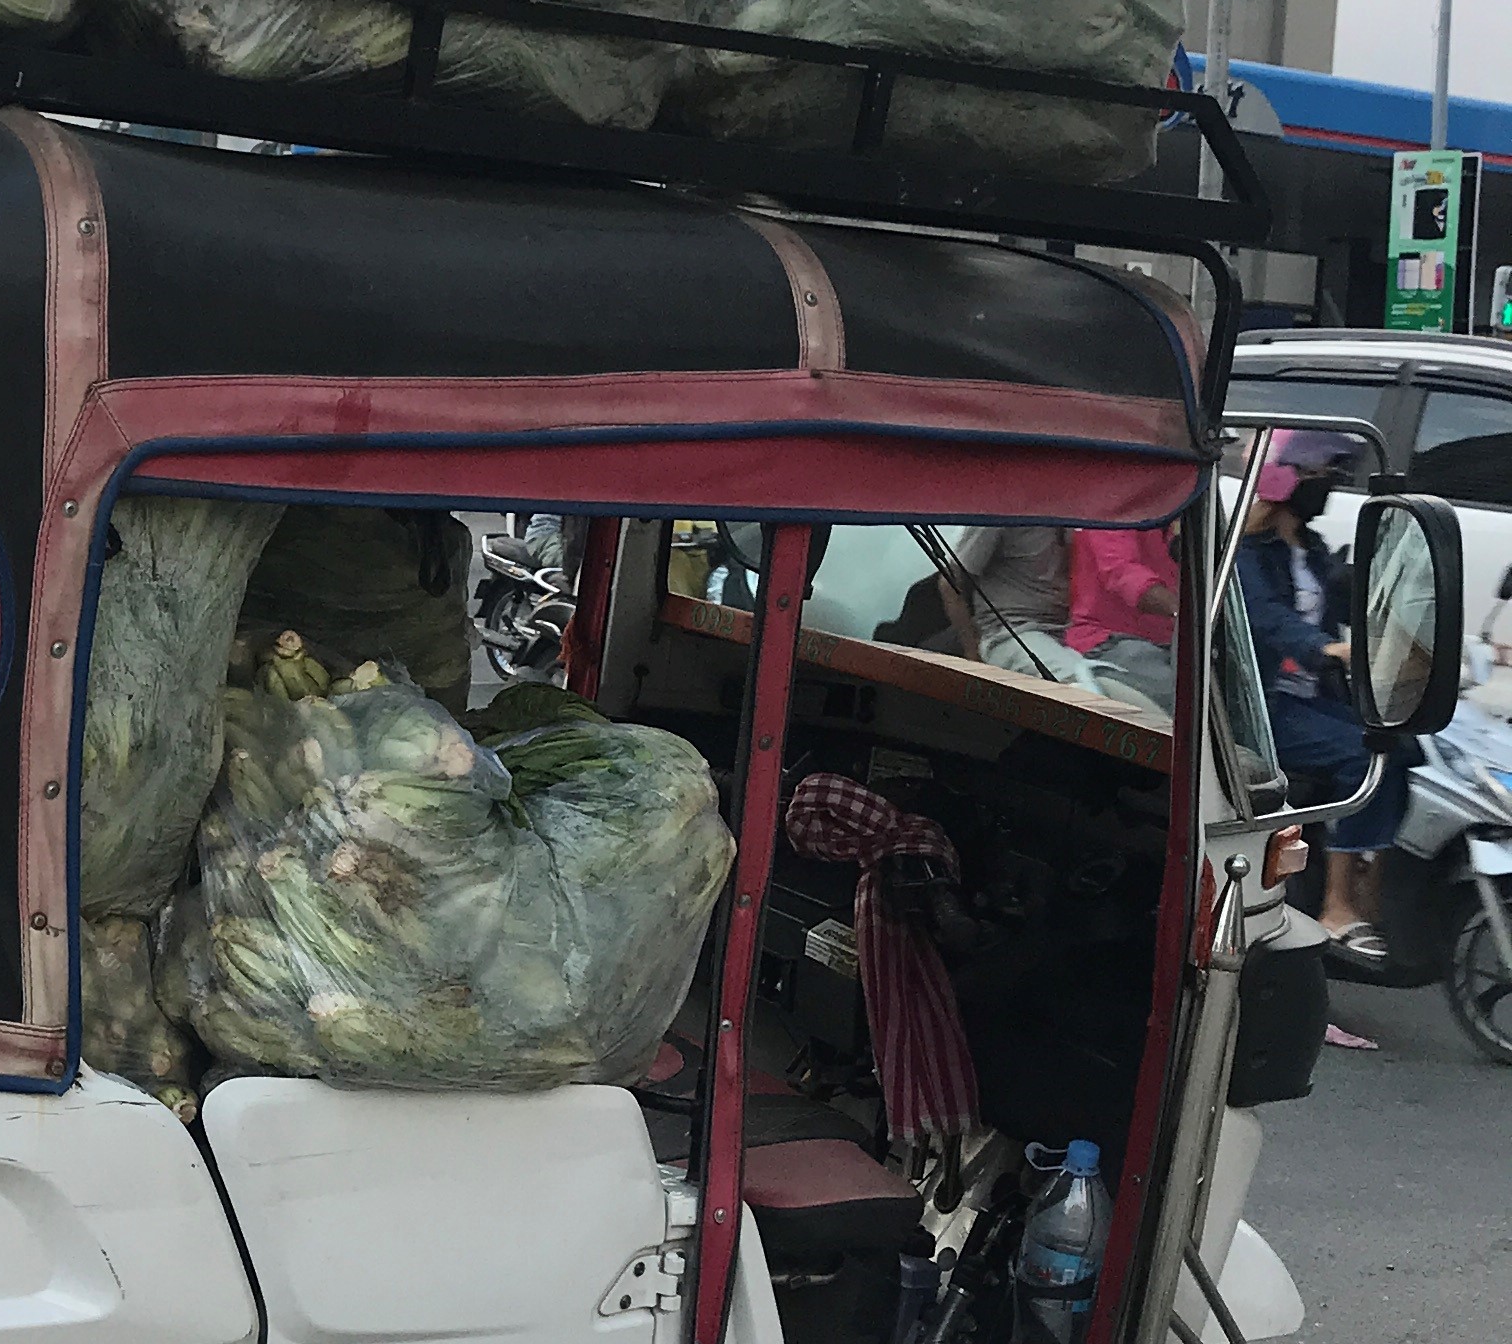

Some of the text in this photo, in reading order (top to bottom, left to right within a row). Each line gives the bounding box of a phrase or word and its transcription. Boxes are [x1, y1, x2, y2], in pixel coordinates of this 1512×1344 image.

[691, 603, 736, 635] 092
[1032, 700, 1092, 740] 527
[1101, 722, 1164, 764] 767
